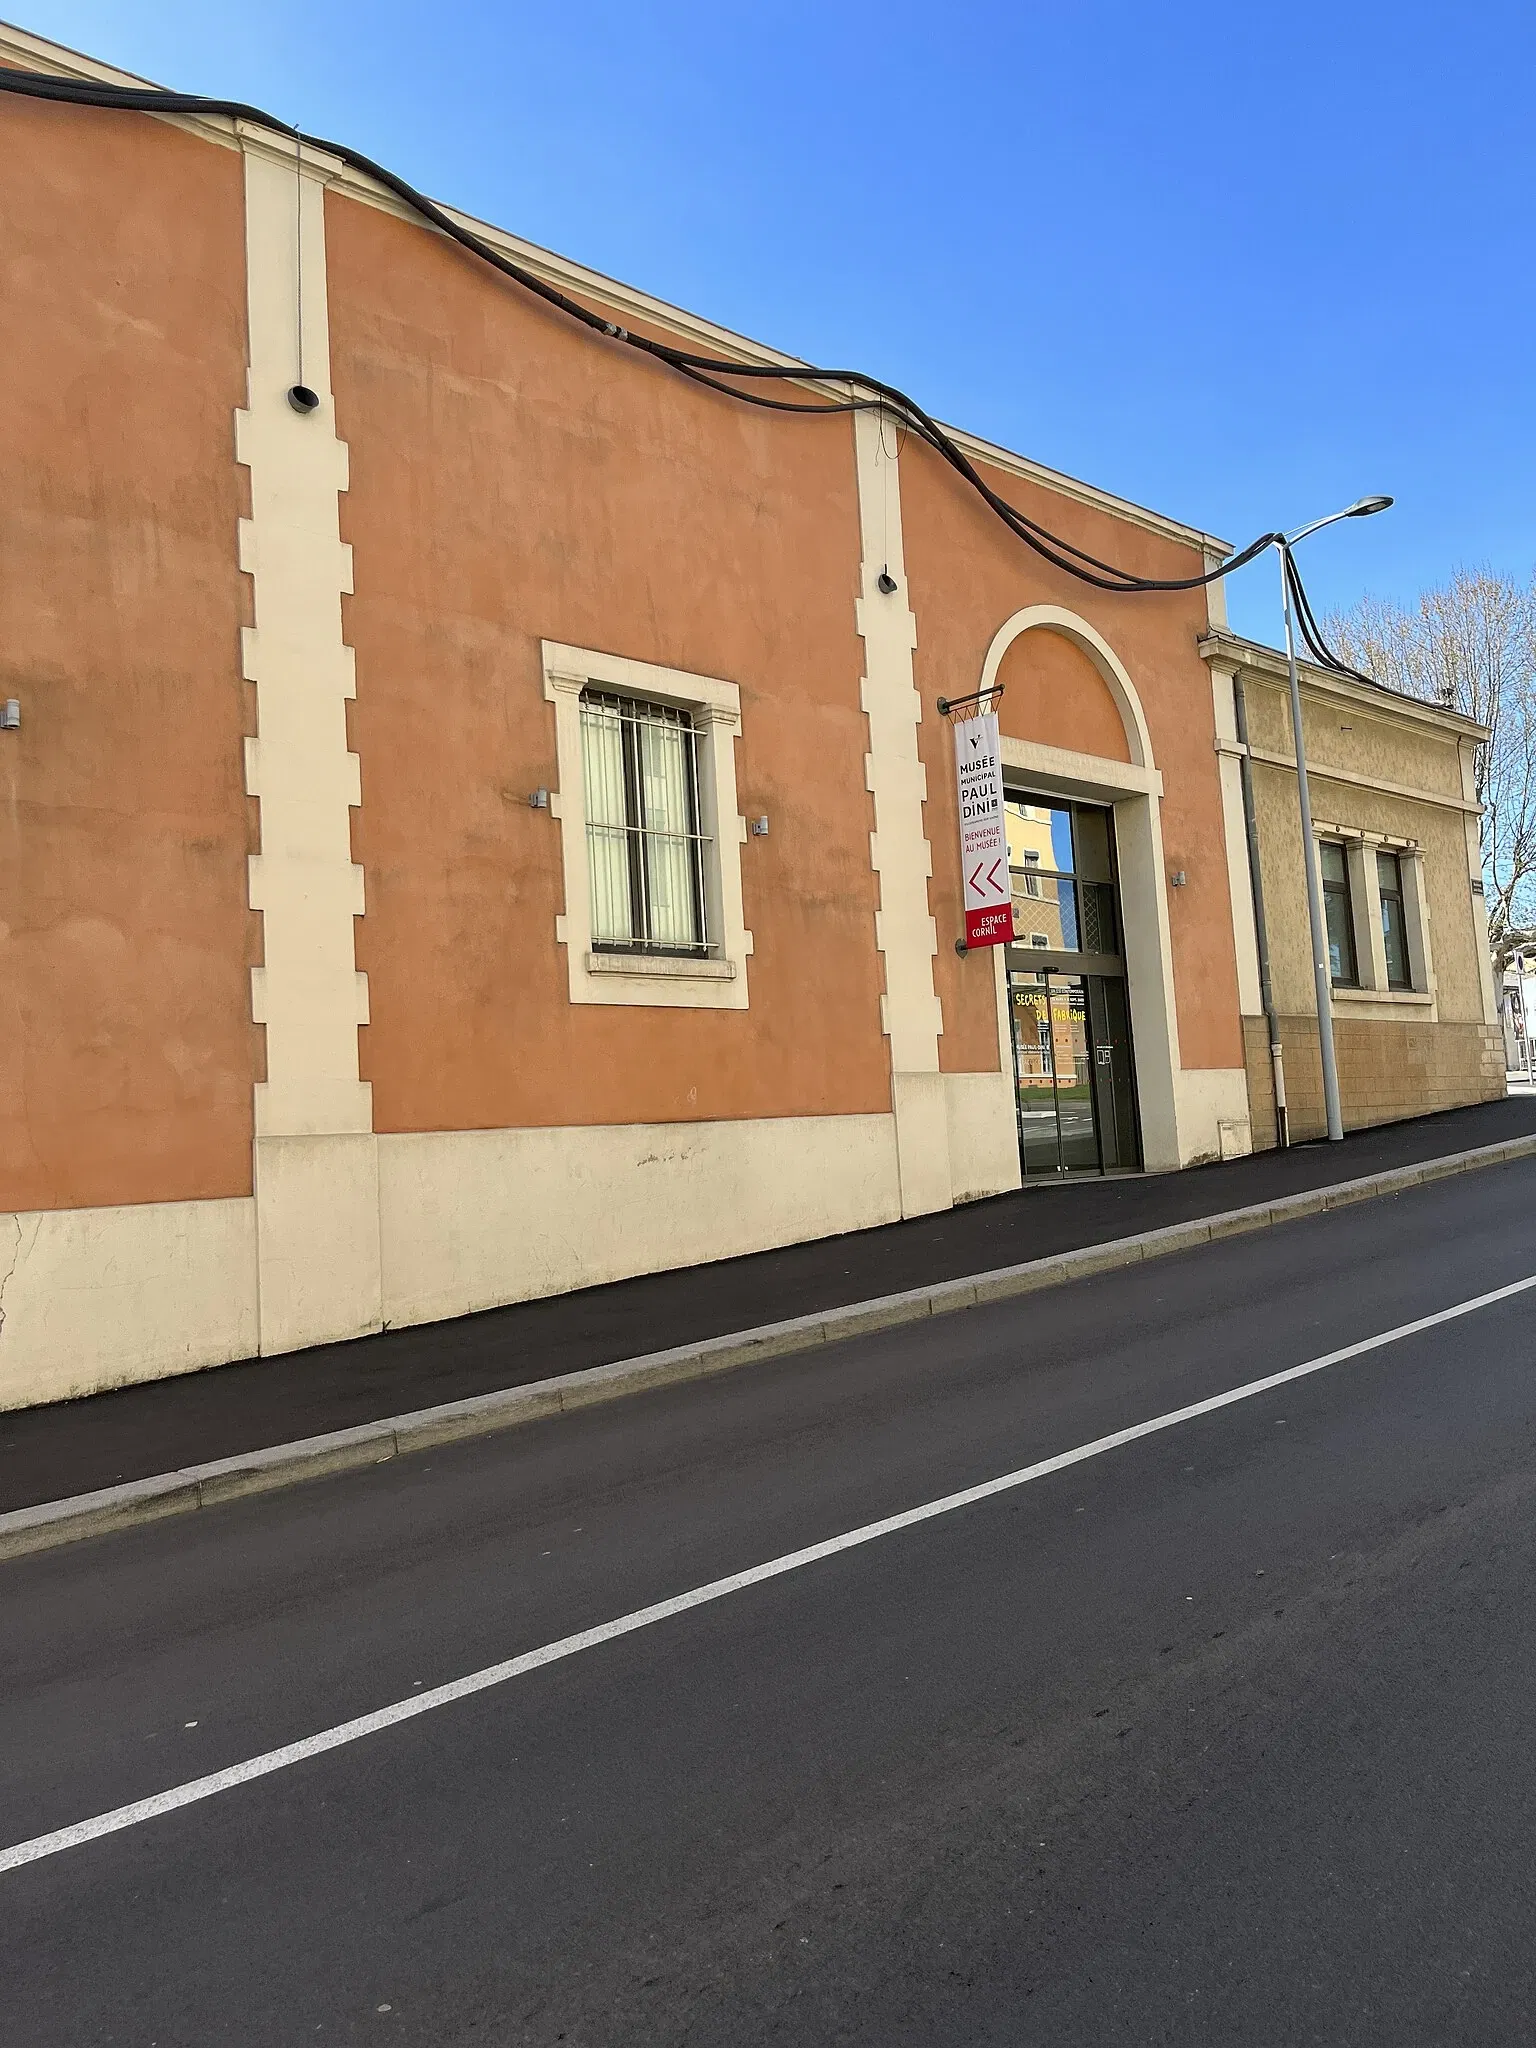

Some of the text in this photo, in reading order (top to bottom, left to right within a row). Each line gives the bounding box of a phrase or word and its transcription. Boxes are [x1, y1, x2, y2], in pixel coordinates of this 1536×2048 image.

[960, 755, 995, 775] MUSÉE
[961, 771, 996, 786] MUNICIPAL
[962, 783, 997, 802] PAUL
[964, 825, 1000, 842] BIENVENUE
[966, 844, 975, 853] AU
[981, 913, 1007, 927] ESPACE
[1015, 993, 1046, 1007] SECRETS
